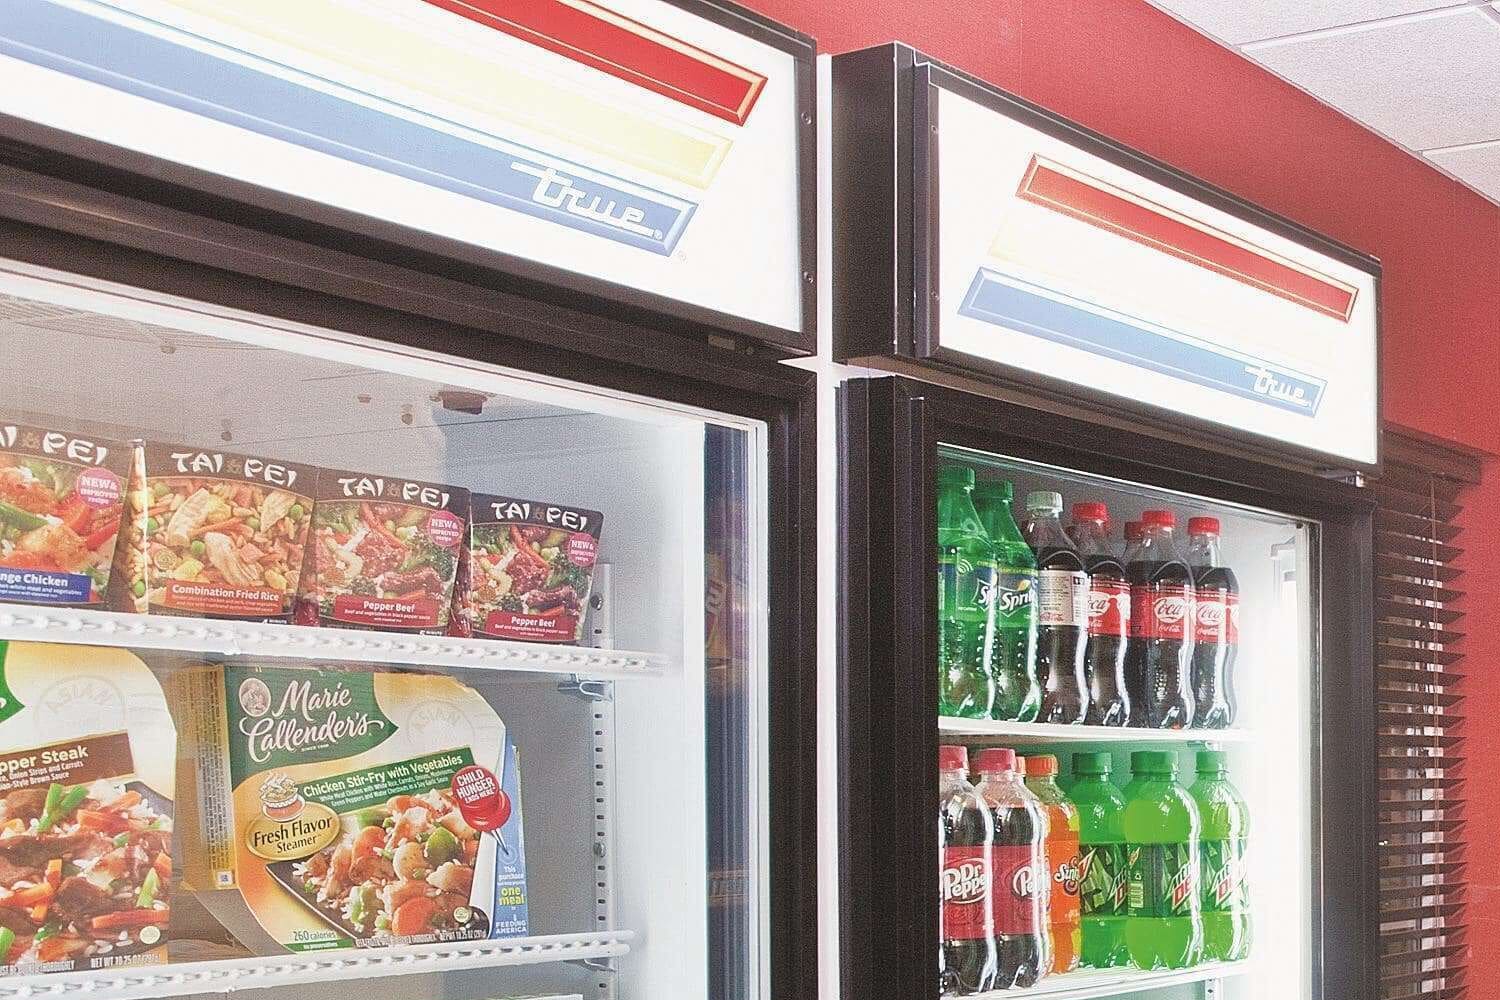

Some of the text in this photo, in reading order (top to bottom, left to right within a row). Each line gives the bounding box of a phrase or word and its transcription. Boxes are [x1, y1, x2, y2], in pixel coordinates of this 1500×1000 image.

[42, 431, 107, 466] PEI
[170, 452, 297, 487] TAI PEI
[338, 477, 449, 508] TAI PEI
[490, 502, 587, 531] TAI PEI
[24, 574, 68, 587] Chicken
[172, 584, 279, 602] Combination Fried Rice
[363, 601, 416, 613] Pepper Beef
[511, 616, 555, 627] Pepper Beef
[272, 680, 352, 717] Marie
[239, 711, 385, 763] Callender's
[41, 745, 88, 765] Steak
[304, 780, 347, 798] Chicken
[347, 771, 386, 788] Stir-Fry
[387, 766, 410, 779] with
[410, 755, 463, 773] Vegetables
[456, 769, 485, 787] CHILD
[456, 776, 495, 798] HUNGER
[253, 816, 333, 848] Fresh Flavor
[276, 836, 317, 855] Steamer
[959, 863, 982, 880] Dr
[498, 894, 525, 906] meal
[501, 887, 521, 897] one
[495, 927, 527, 935] AMERICA
